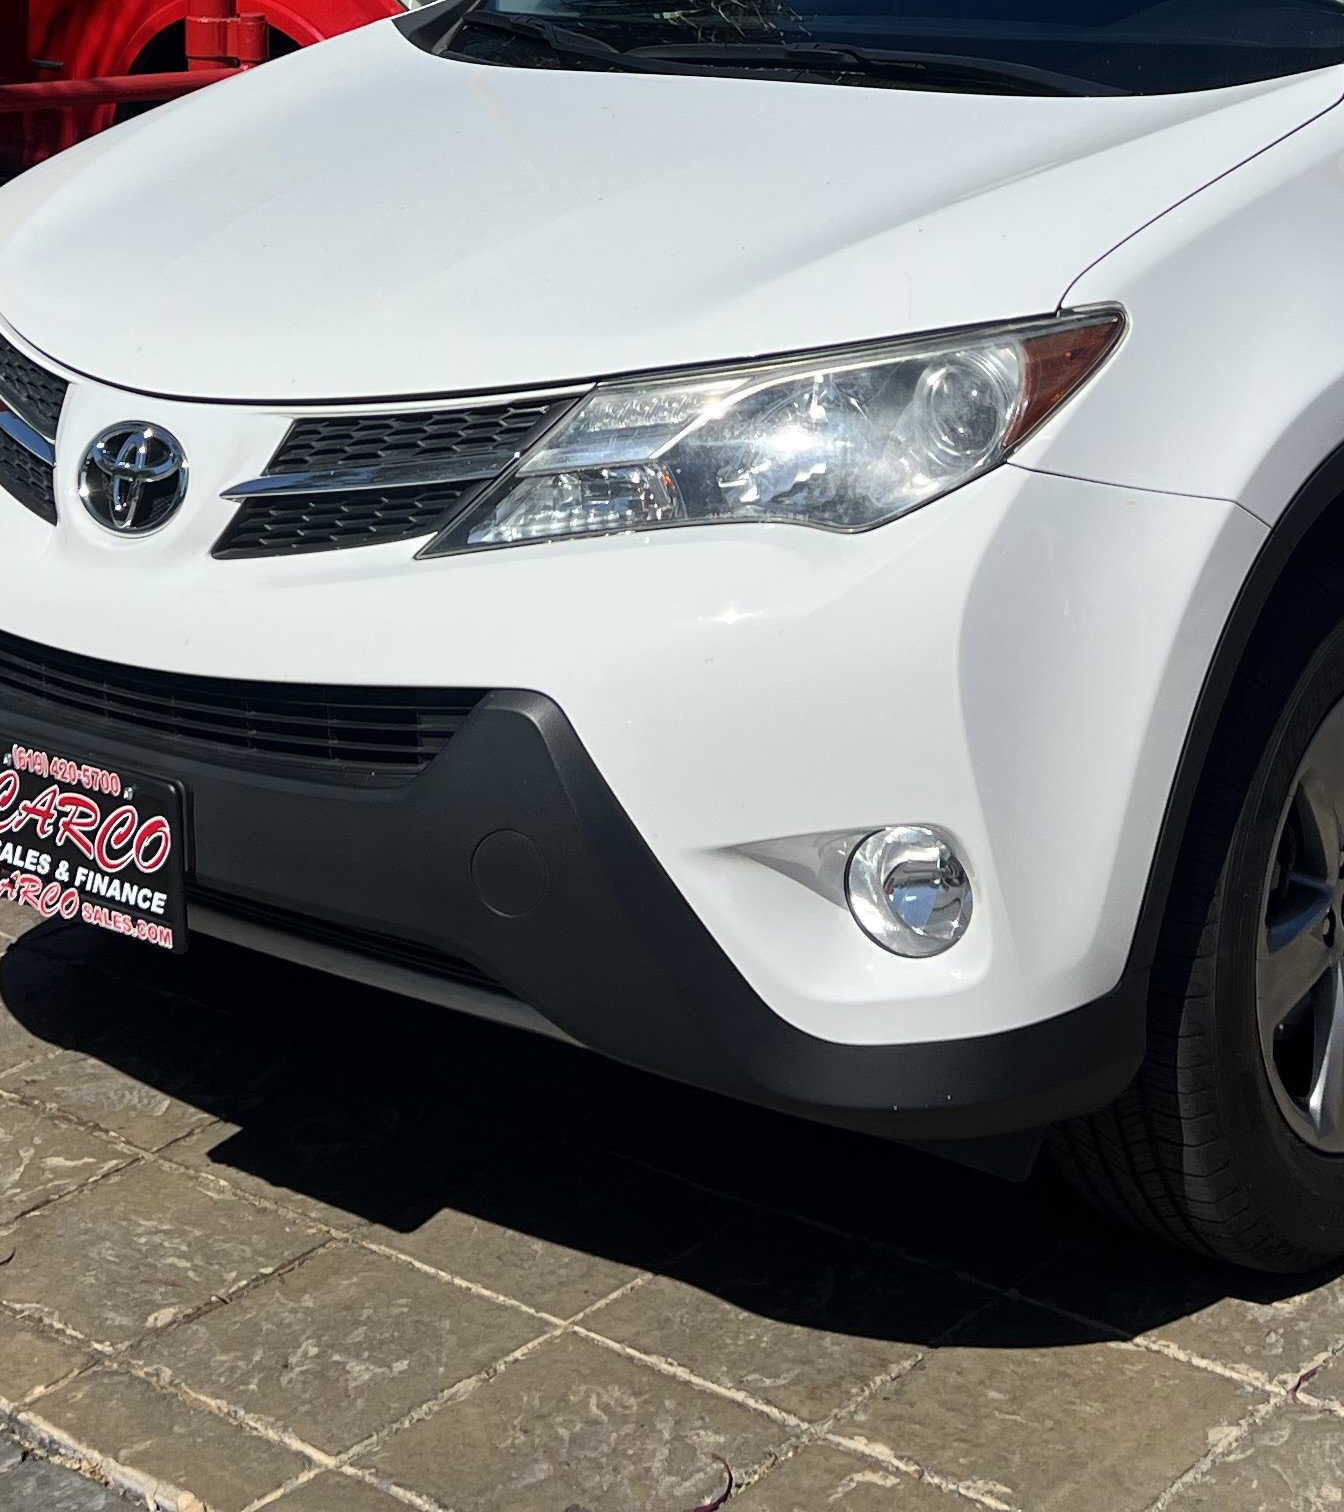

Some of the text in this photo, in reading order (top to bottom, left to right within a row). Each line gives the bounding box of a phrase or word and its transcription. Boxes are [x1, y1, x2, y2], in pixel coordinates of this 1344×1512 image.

[11, 744, 122, 797] (619) 420-5700
[55, 860, 70, 883] &
[74, 866, 168, 915] FINANCE
